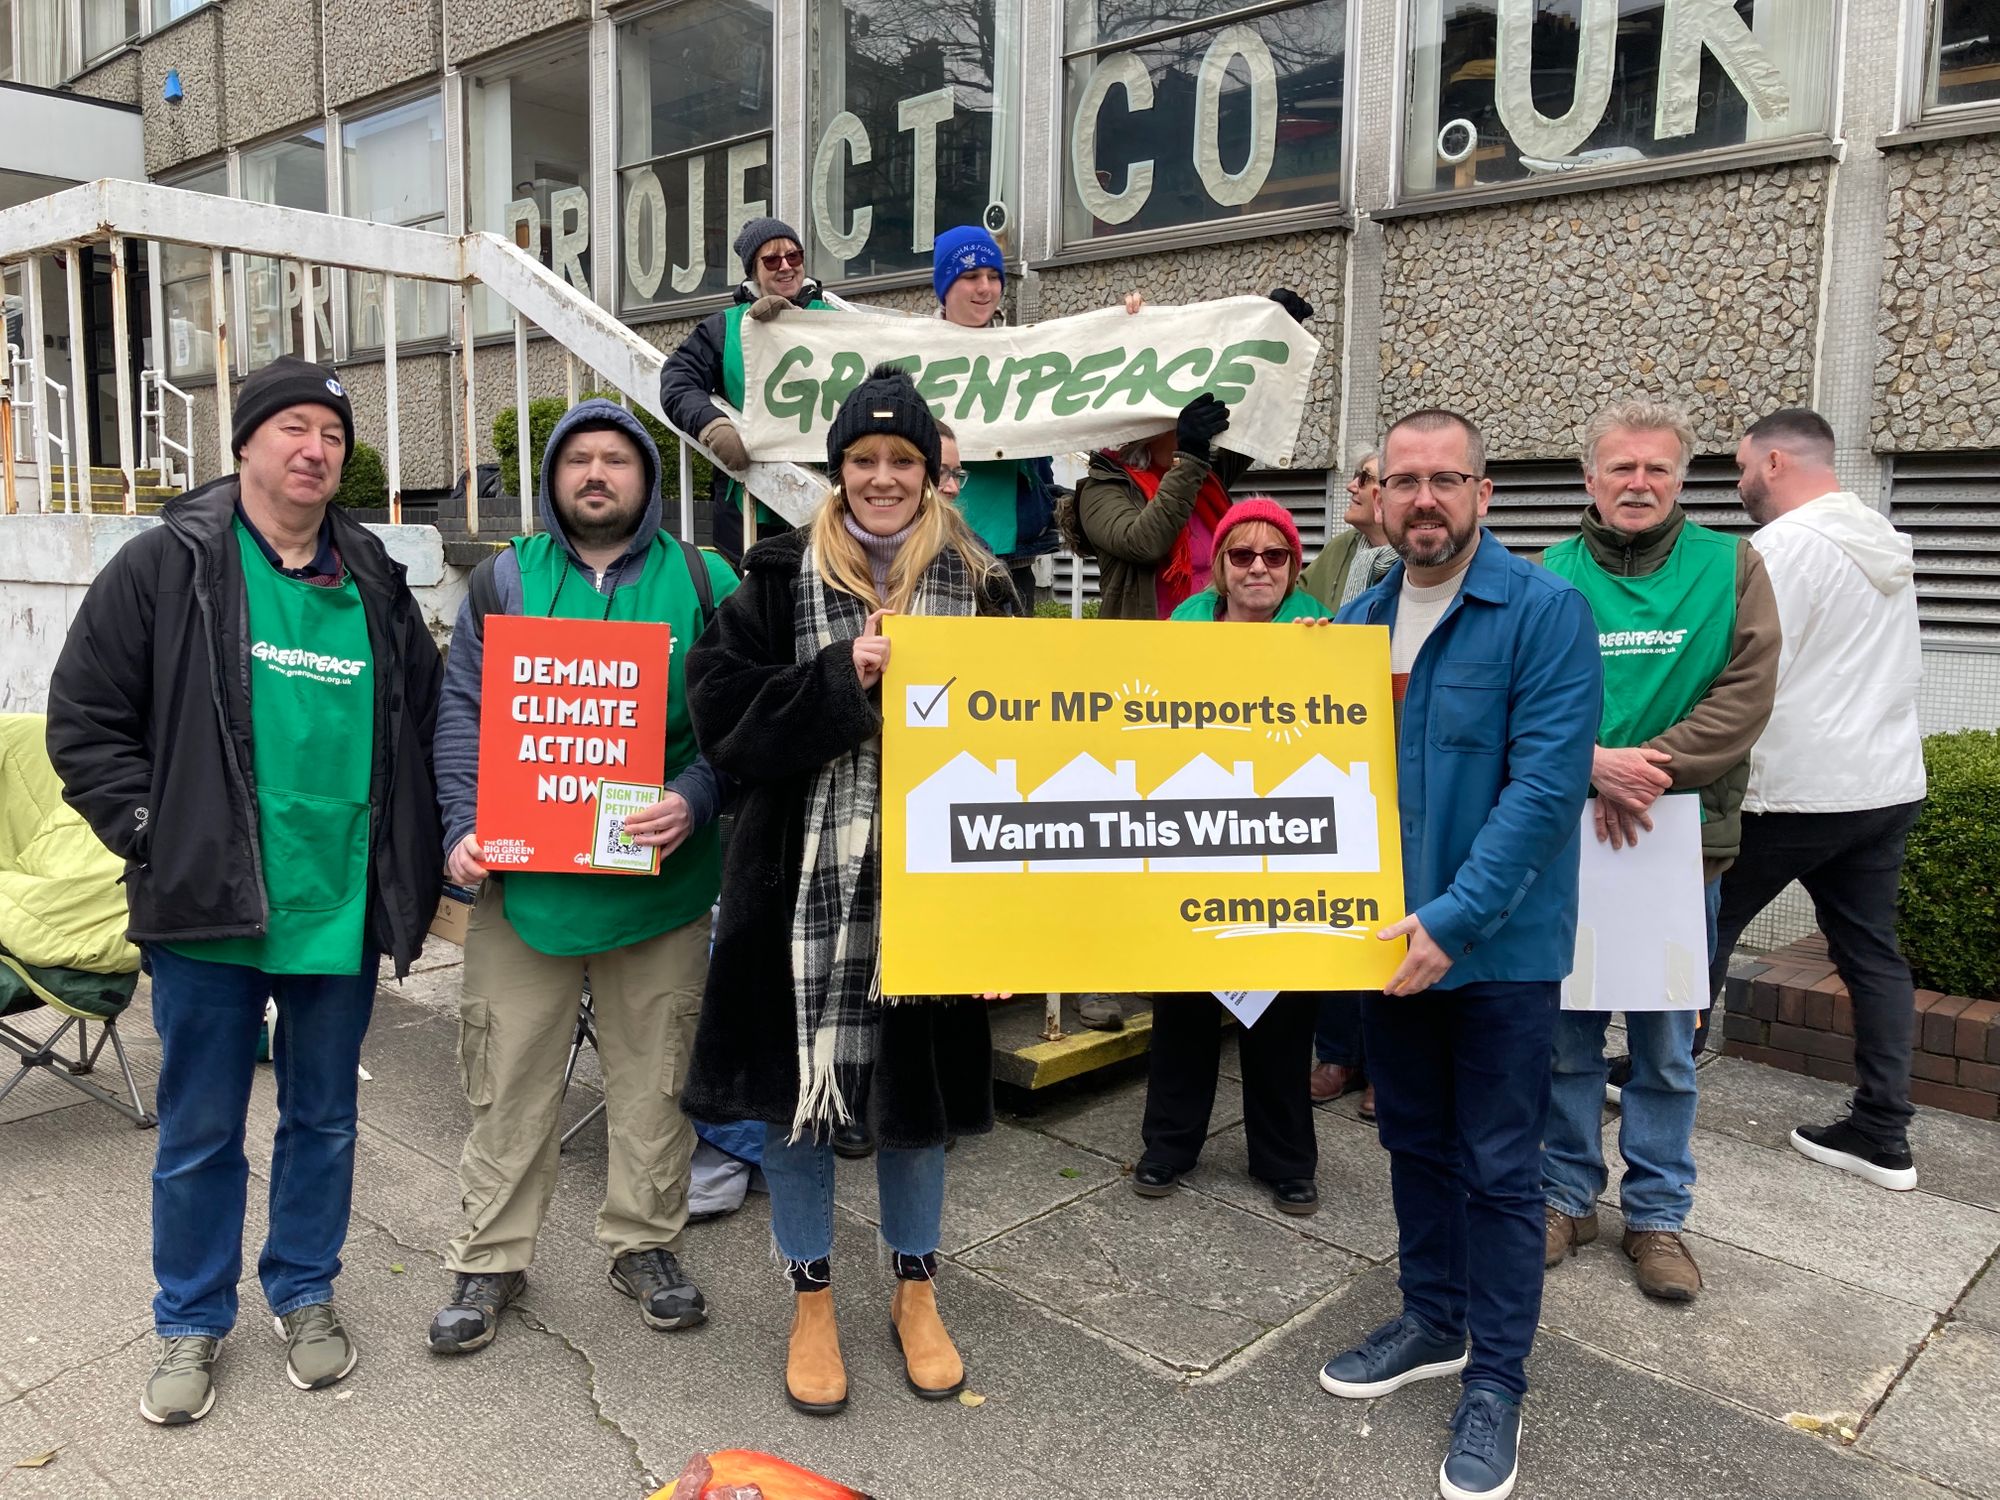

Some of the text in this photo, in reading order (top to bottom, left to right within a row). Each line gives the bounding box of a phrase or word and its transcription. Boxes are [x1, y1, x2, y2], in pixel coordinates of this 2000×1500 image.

[251, 641, 367, 676] GREENPEACE
[268, 663, 352, 685] www.greenpeace.org.uk
[513, 655, 640, 689] DEMAND
[511, 695, 638, 728] CLIMATE
[967, 690, 1368, 729] Our MP supports the
[518, 734, 627, 767] ACTION
[605, 788, 655, 804] SIGN THE
[496, 839, 526, 848] GREAT
[958, 810, 1329, 851] Warm This Winter
[484, 845, 535, 856] BIG GREEN
[484, 853, 520, 865] WEEK
[1179, 889, 1380, 929] campaign
